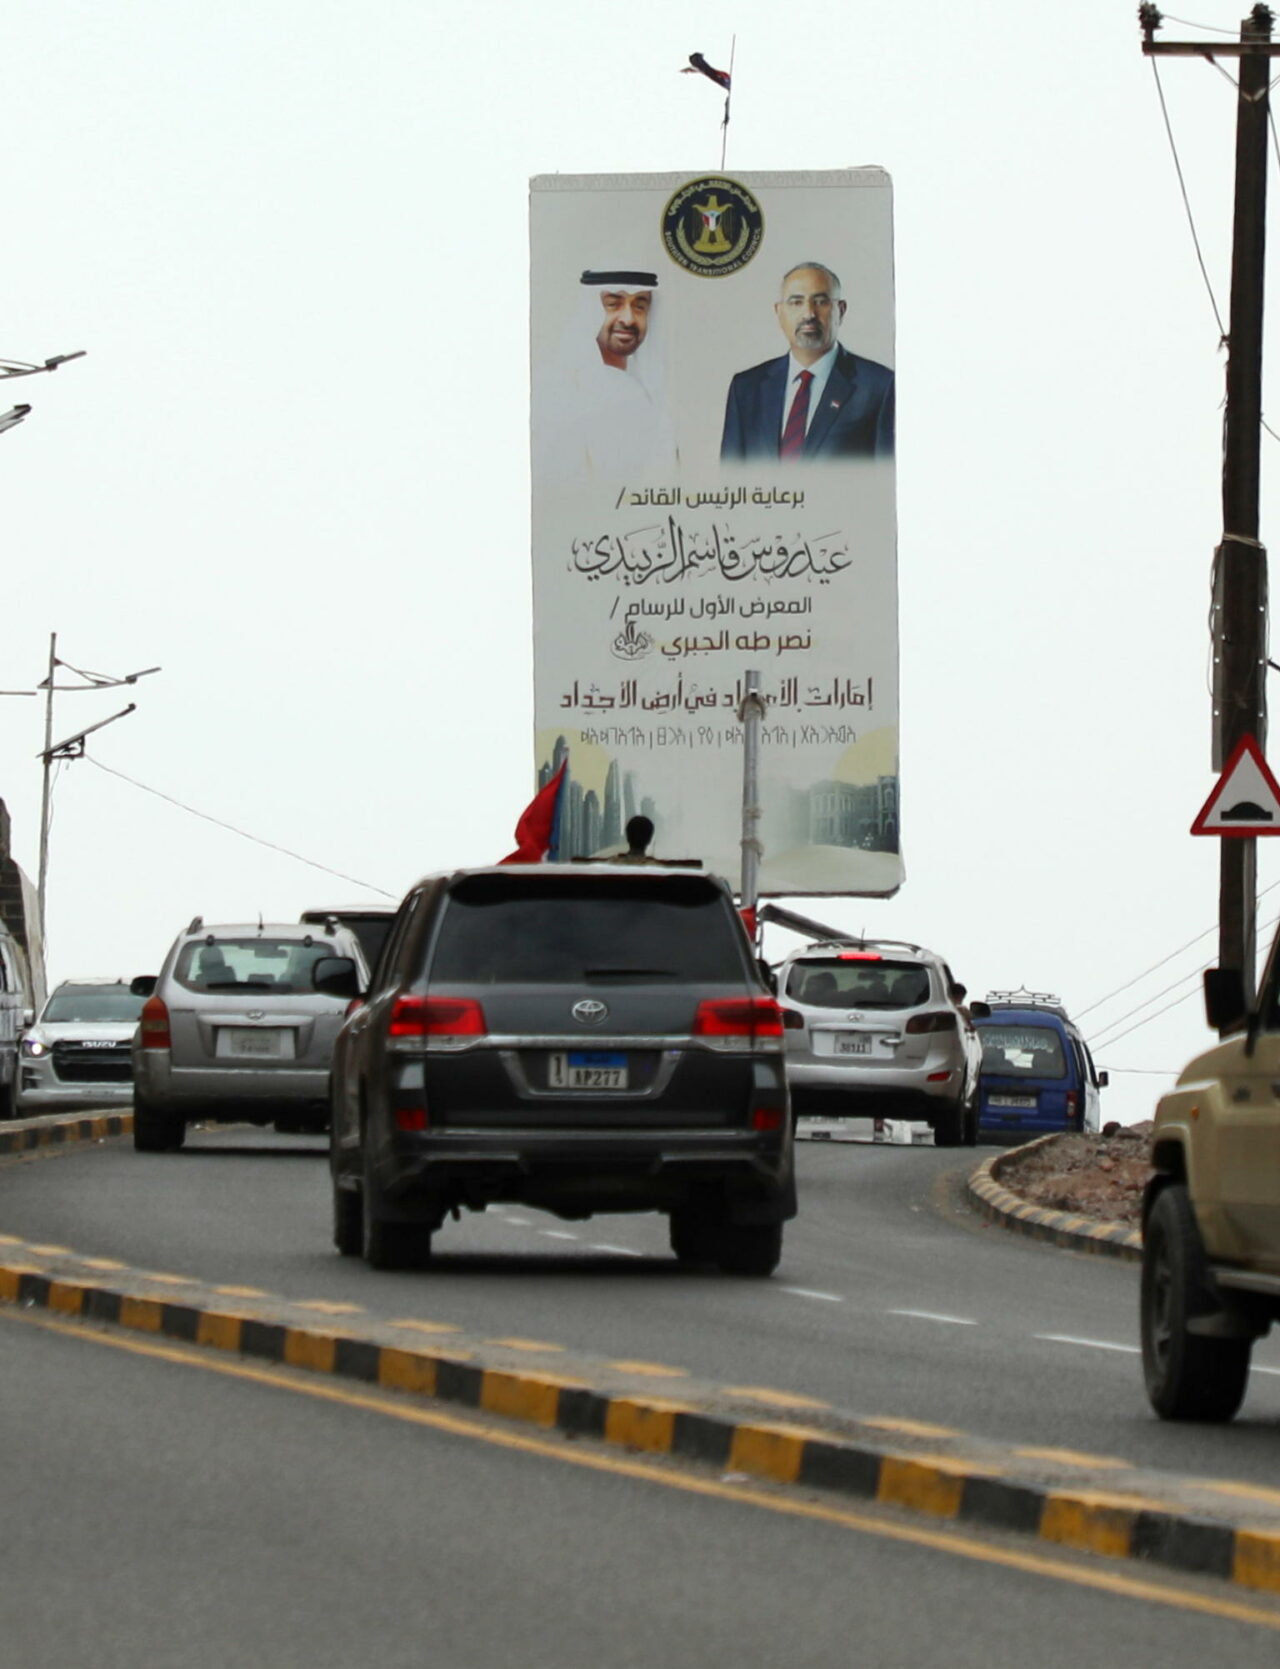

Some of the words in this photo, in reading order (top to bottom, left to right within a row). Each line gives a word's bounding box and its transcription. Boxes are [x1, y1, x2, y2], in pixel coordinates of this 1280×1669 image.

[630, 486, 681, 506] القائد
[685, 486, 747, 510] الرئيس
[751, 486, 805, 509] برعاية
[624, 597, 685, 624] للرسام
[689, 595, 735, 619] الأول
[739, 596, 812, 619] المعرض
[661, 630, 729, 661] الجبري
[735, 630, 771, 652] طه
[776, 629, 811, 656] نصر
[684, 686, 717, 715] في
[81, 1040, 117, 1048] ISUZU
